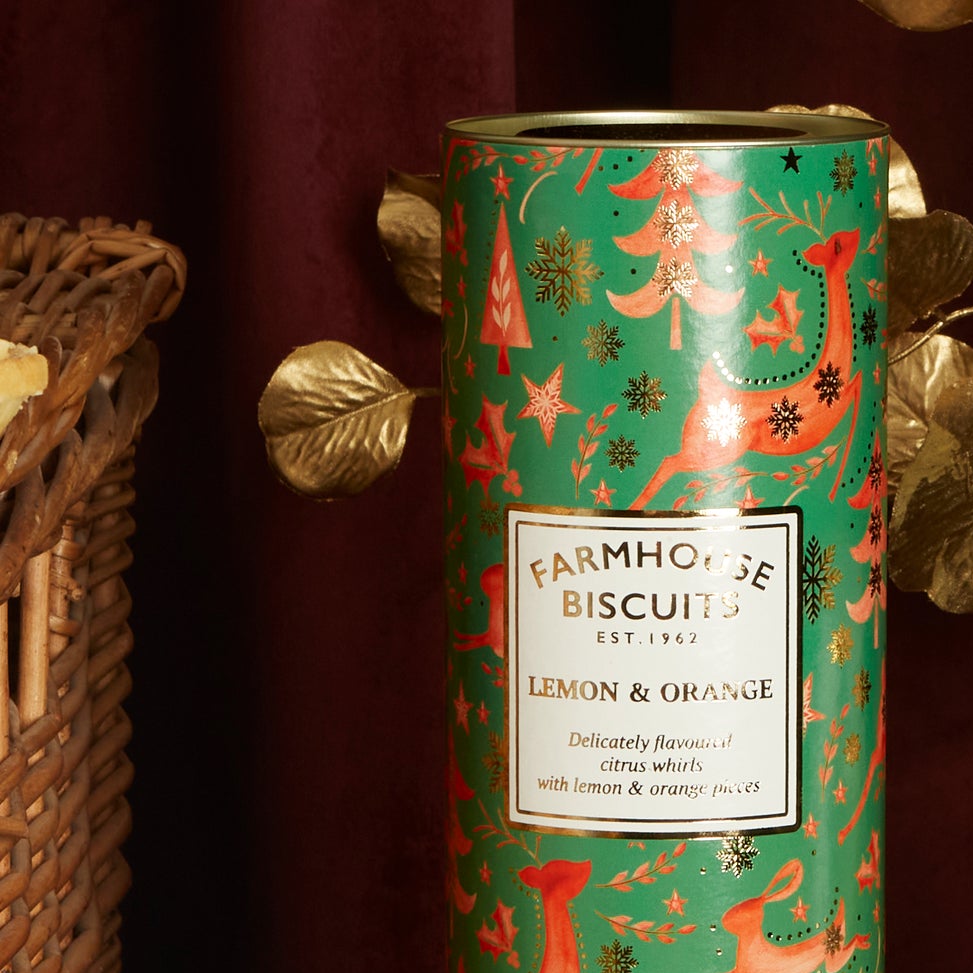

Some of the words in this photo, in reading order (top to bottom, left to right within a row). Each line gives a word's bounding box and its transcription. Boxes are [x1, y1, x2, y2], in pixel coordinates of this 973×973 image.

[529, 541, 774, 590] FARMHOUSE
[562, 590, 740, 620] BISCUITS
[528, 676, 619, 702] LEMON
[629, 683, 650, 702] &
[660, 679, 774, 702] ORANGE
[568, 732, 650, 753] Delicately
[653, 733, 733, 753] flavoured
[600, 757, 647, 773] citrus
[653, 757, 703, 773] whirls
[537, 776, 568, 792] with
[573, 777, 622, 795] lemon
[628, 780, 643, 795] &
[650, 783, 708, 799] orange
[712, 779, 760, 797] pieces
